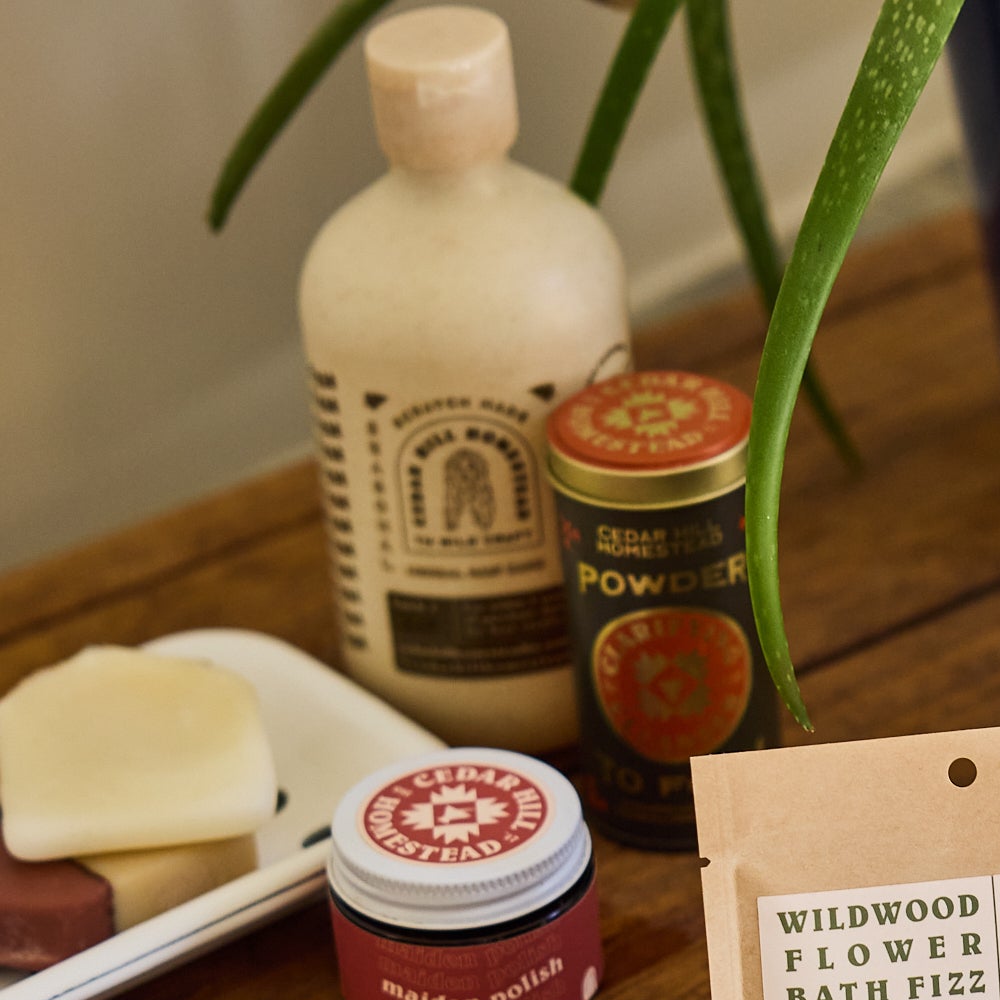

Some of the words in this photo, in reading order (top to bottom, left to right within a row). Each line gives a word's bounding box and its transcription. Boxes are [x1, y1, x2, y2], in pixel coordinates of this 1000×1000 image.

[596, 524, 668, 542] CEDAR
[577, 551, 747, 597] POWDER
[413, 767, 521, 791] CEDAR
[510, 788, 542, 830] HILL
[368, 796, 502, 861] HOMESTEAD
[777, 894, 980, 934] WILDWOOD
[785, 933, 982, 972] FLOWER
[908, 970, 986, 999] FIZZ
